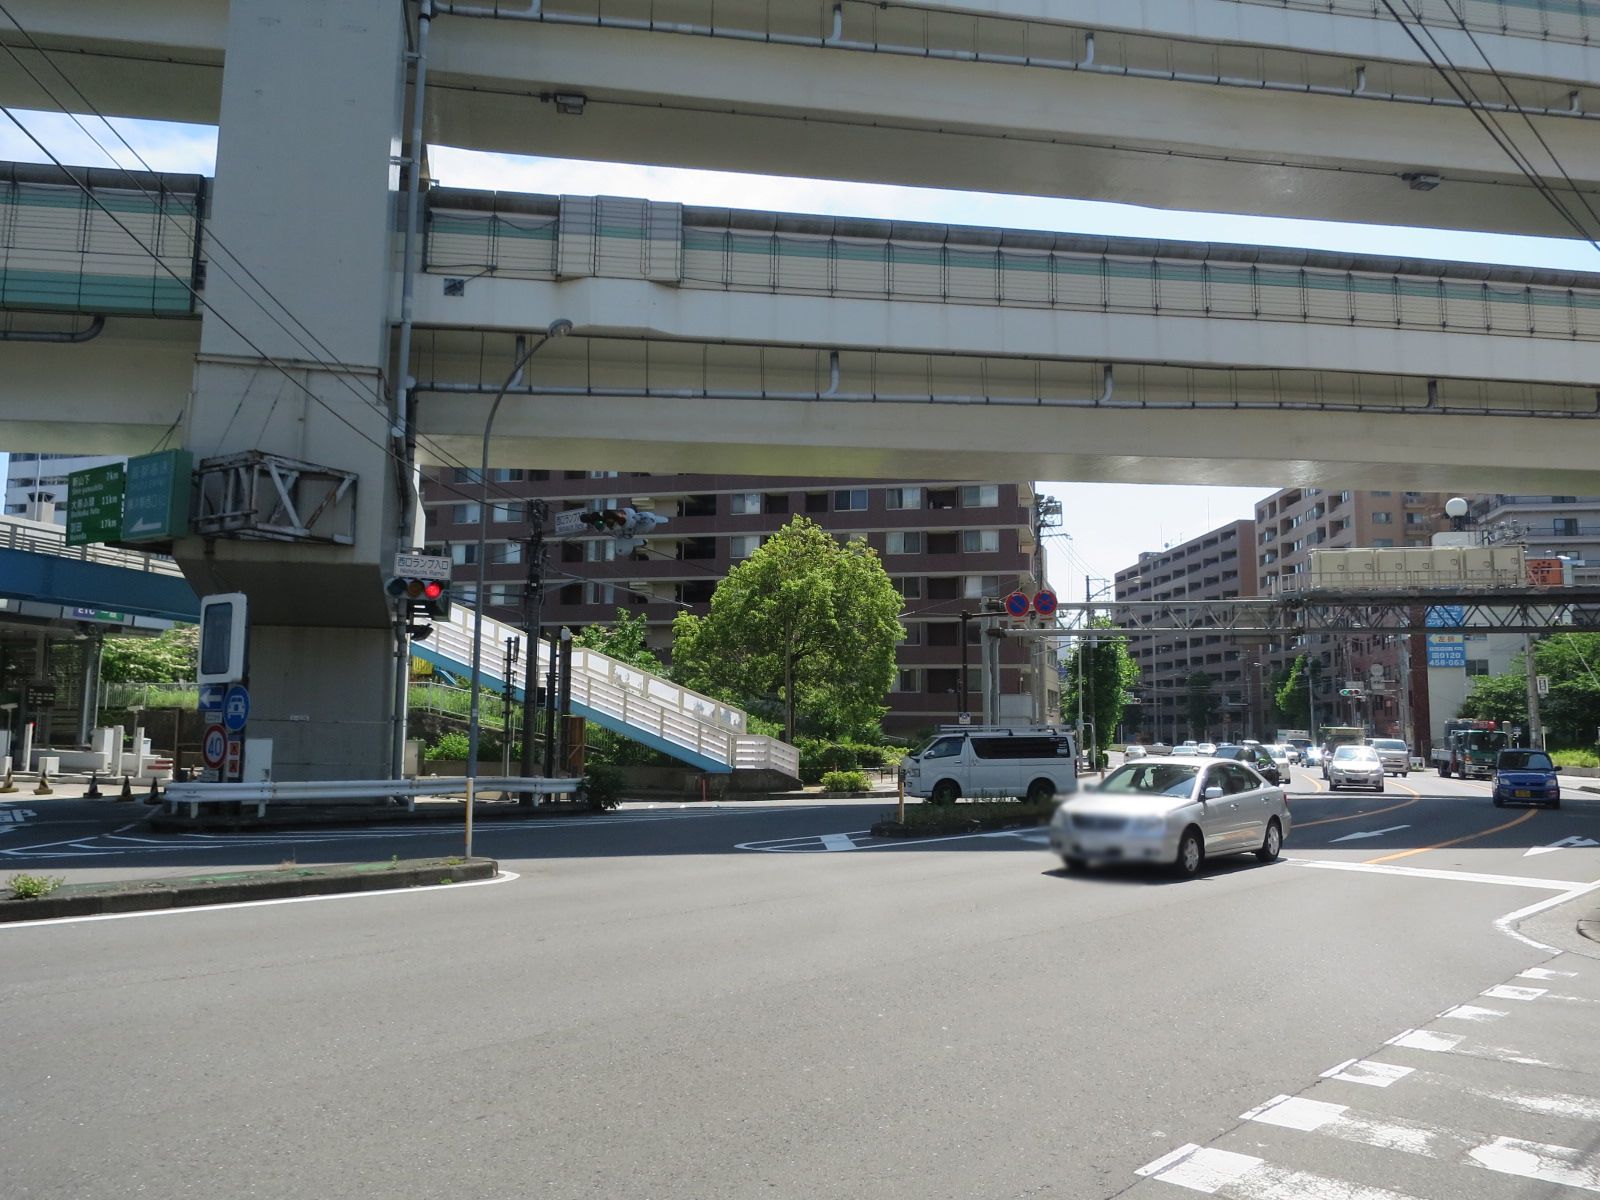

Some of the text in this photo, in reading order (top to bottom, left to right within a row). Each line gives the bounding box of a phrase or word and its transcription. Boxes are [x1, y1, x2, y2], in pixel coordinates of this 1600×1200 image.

[101, 495, 118, 505] 11km
[101, 519, 117, 529] 17km
[397, 557, 449, 570] 西口ランプ入口
[207, 737, 222, 757] 40
